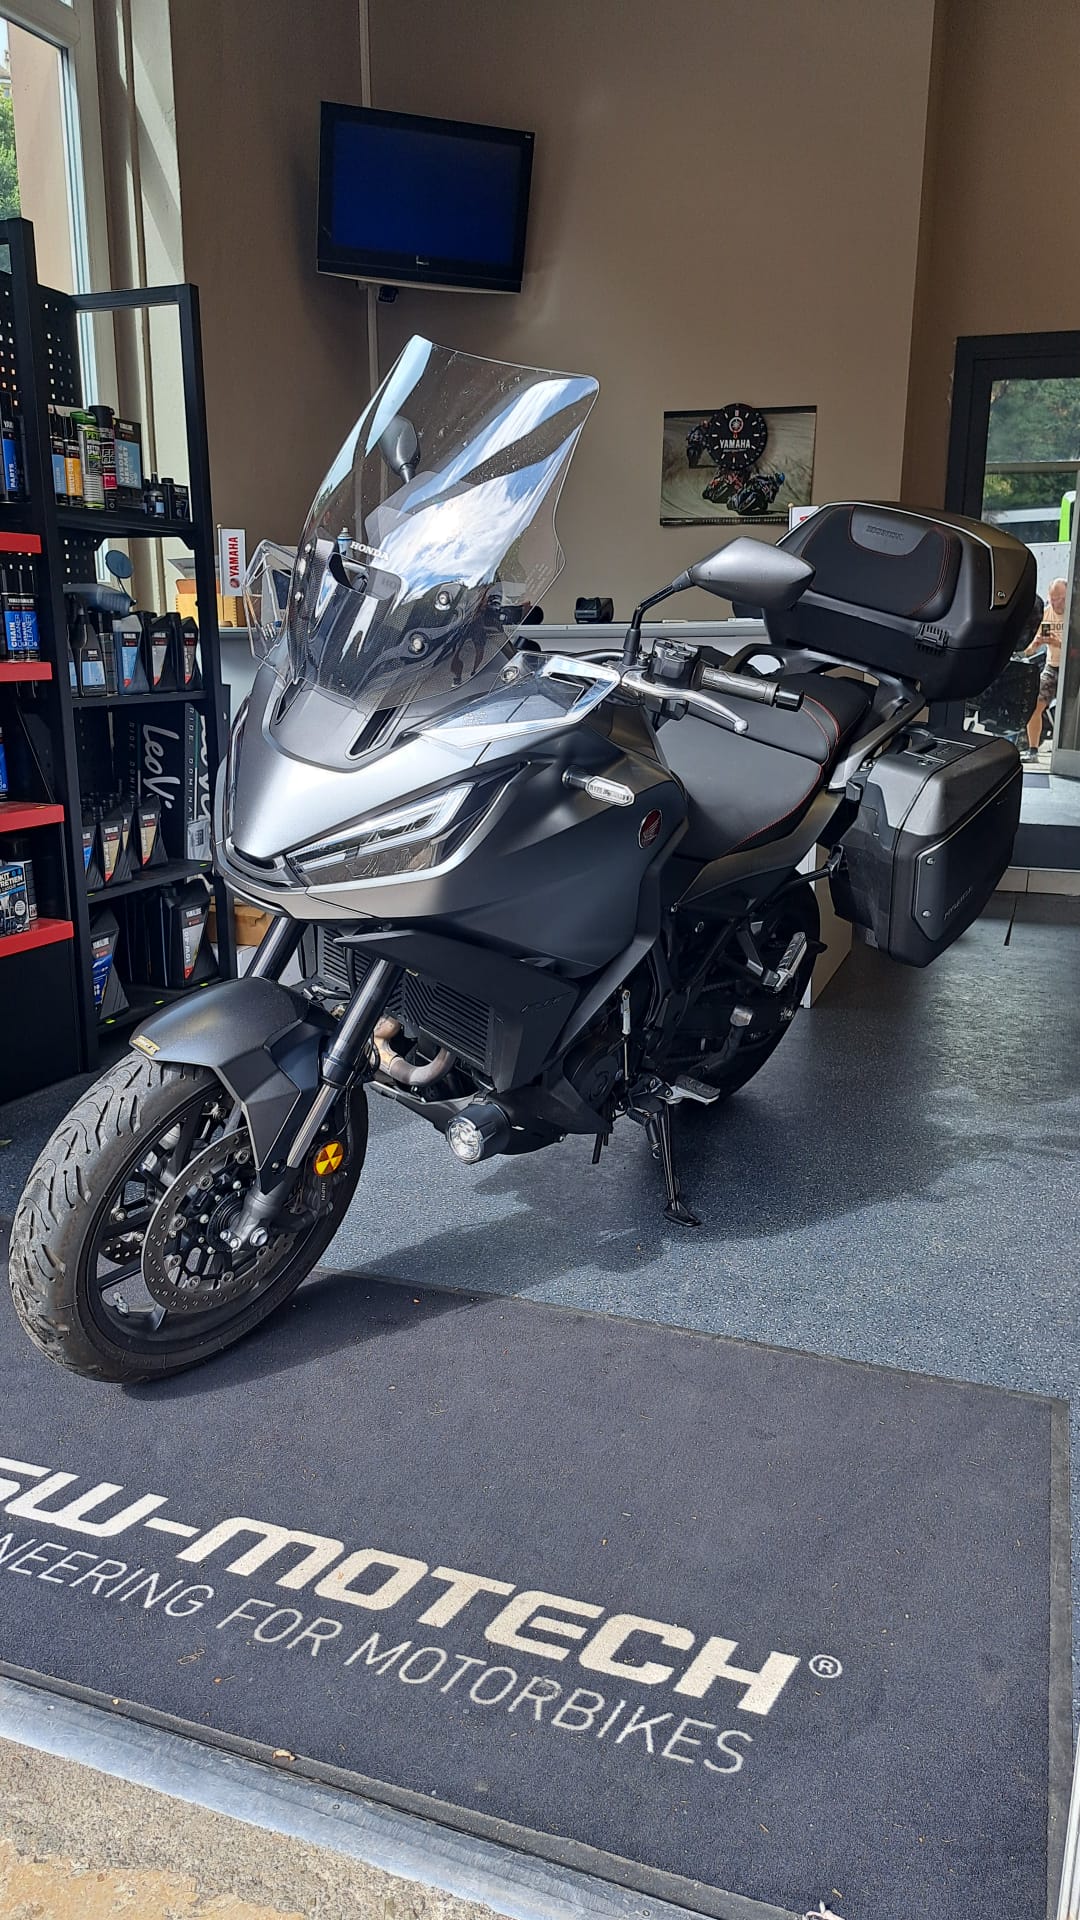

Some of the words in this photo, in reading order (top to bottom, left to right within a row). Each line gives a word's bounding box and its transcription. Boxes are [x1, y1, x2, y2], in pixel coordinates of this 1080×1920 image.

[719, 439, 751, 449] YAMAHA
[228, 536, 240, 577] YAMAHA
[350, 541, 389, 560] HONDA
[9, 622, 17, 647] CHAIN
[25, 614, 33, 647] CLEANER
[216, 1598, 344, 1657] FOR
[343, 1632, 755, 1774] MOTORBIKES
